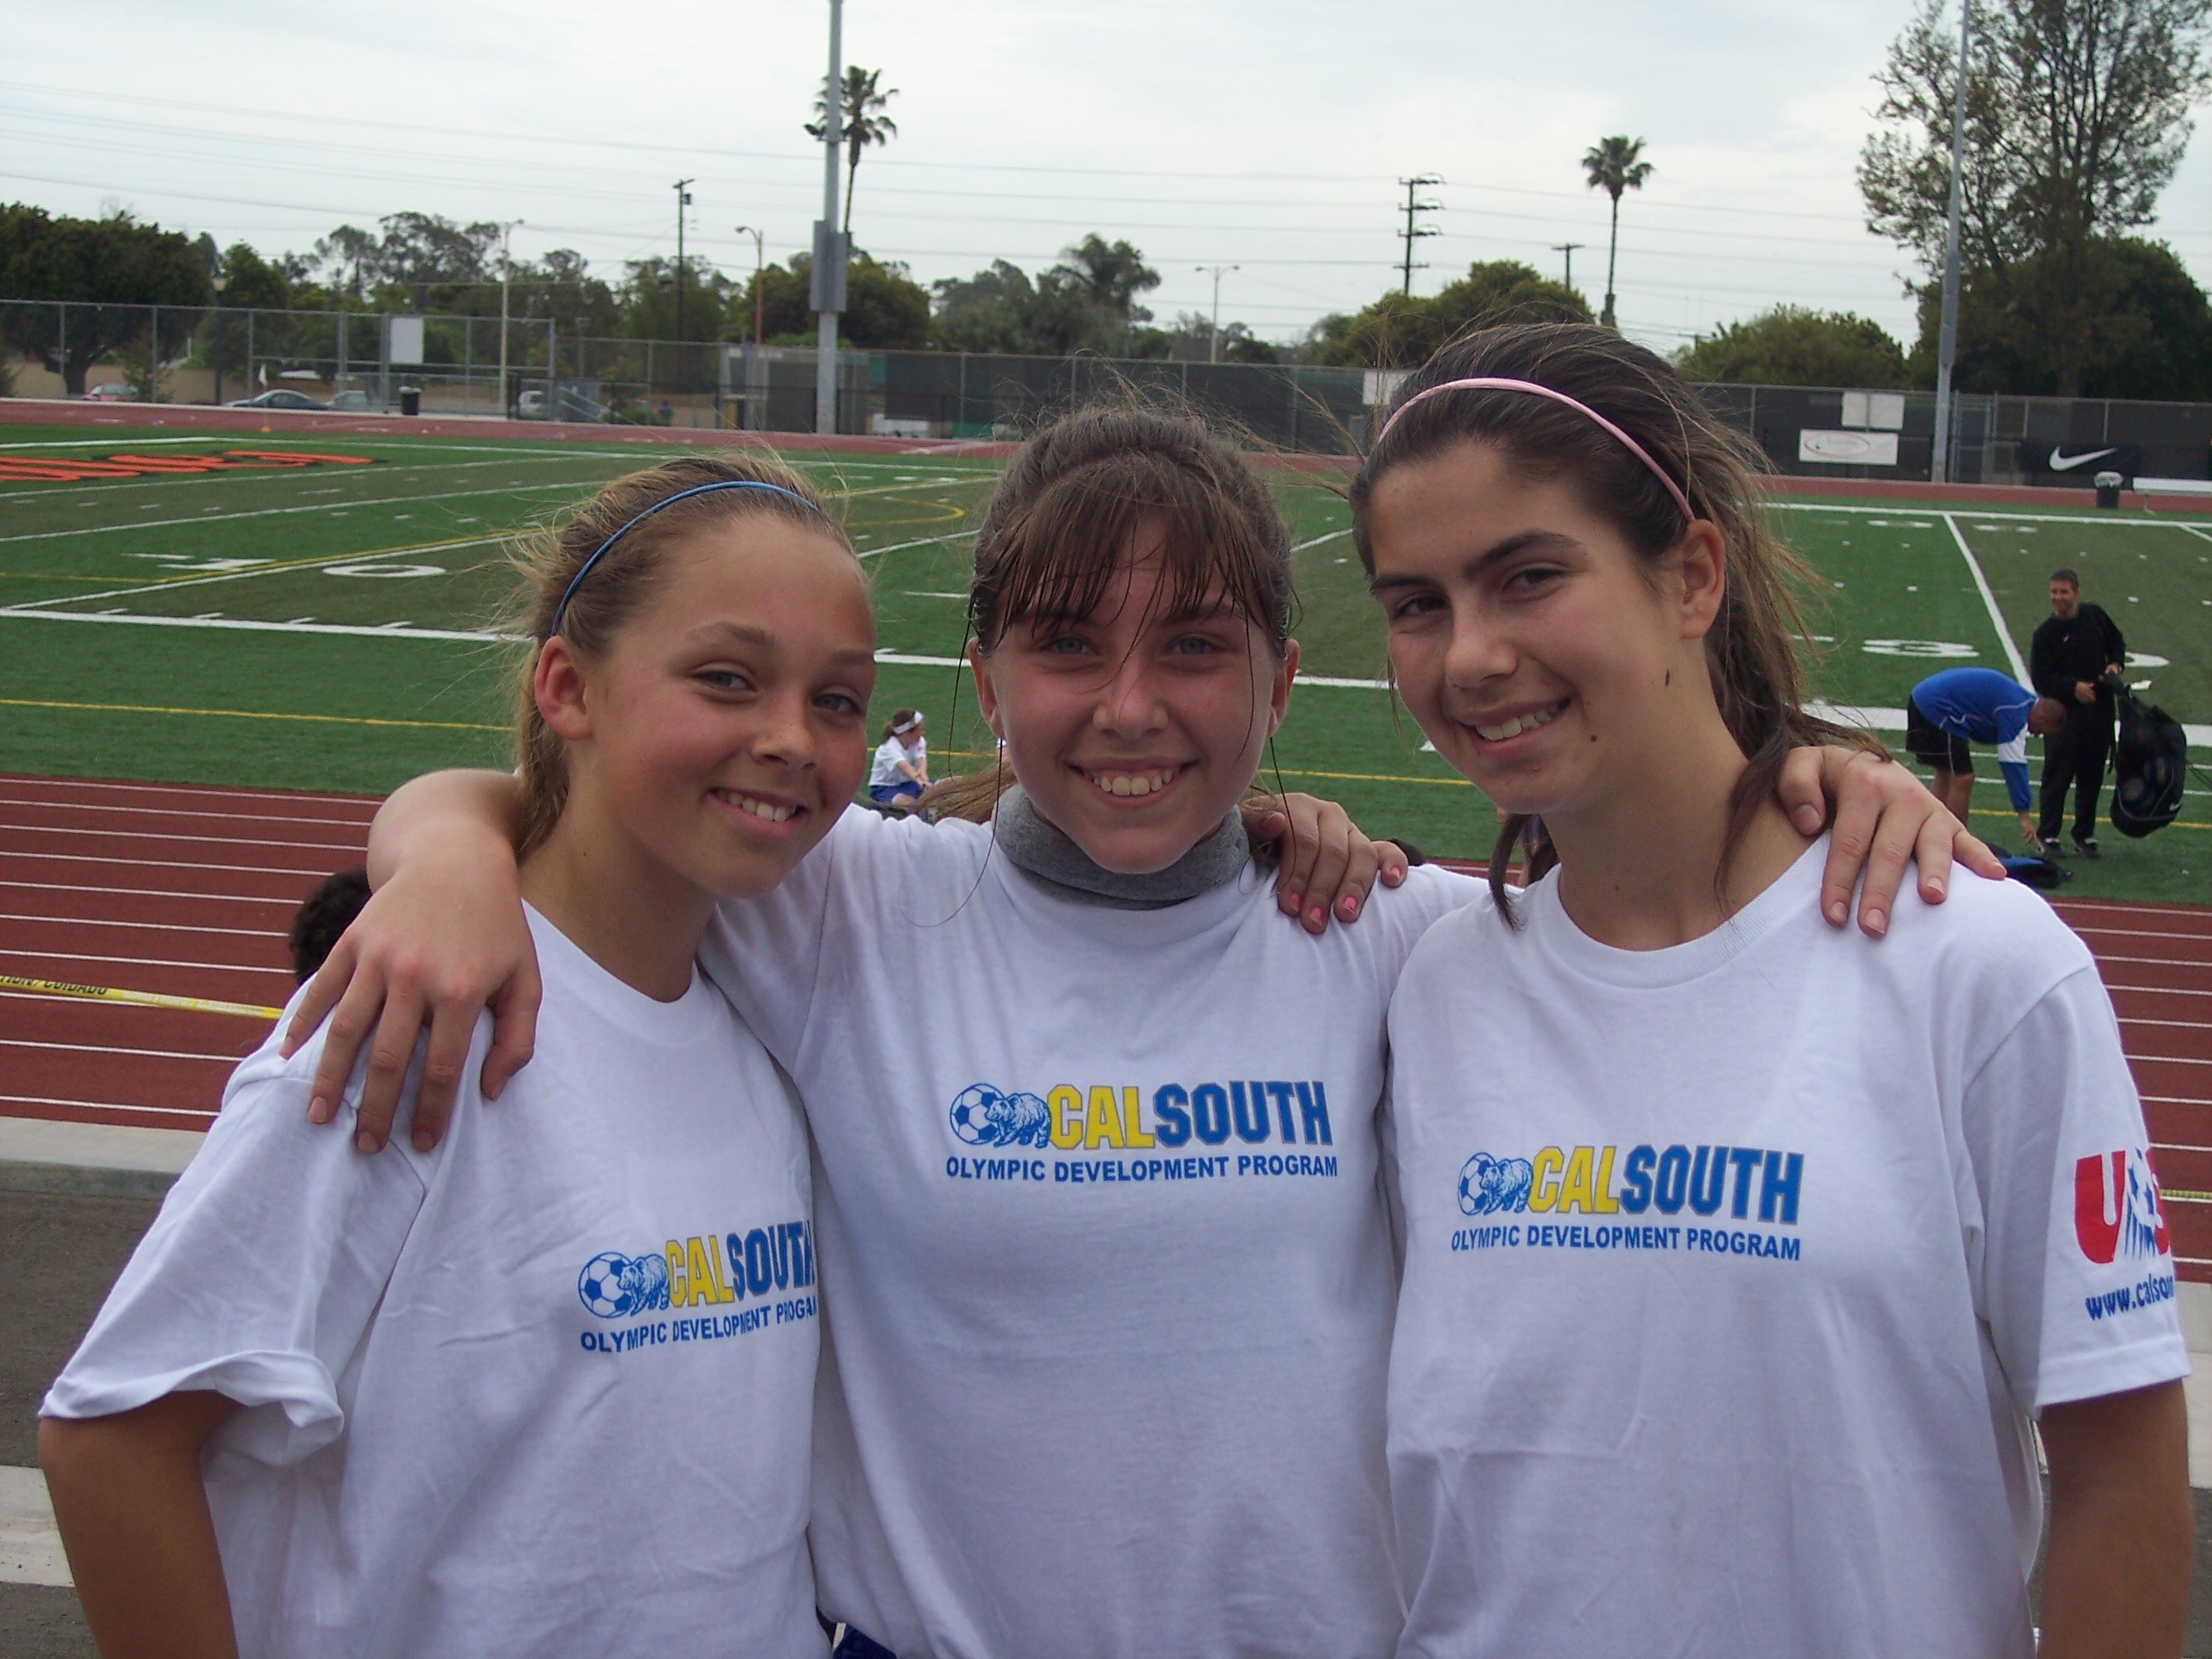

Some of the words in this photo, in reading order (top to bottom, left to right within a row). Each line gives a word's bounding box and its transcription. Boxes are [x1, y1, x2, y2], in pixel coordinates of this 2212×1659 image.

[945, 1156, 1046, 1181] OLYMPIC
[1053, 1155, 1230, 1183] DEVELOPMENT
[1238, 1154, 1338, 1178] PROGRAM
[1451, 1224, 1520, 1252] OLYMPIC
[1527, 1225, 1681, 1250] DEVELOPMENT
[1686, 1227, 1802, 1262] PROGRAM
[580, 1321, 668, 1354] OLYMPIC
[672, 1305, 771, 1342] DEVELOPMENT
